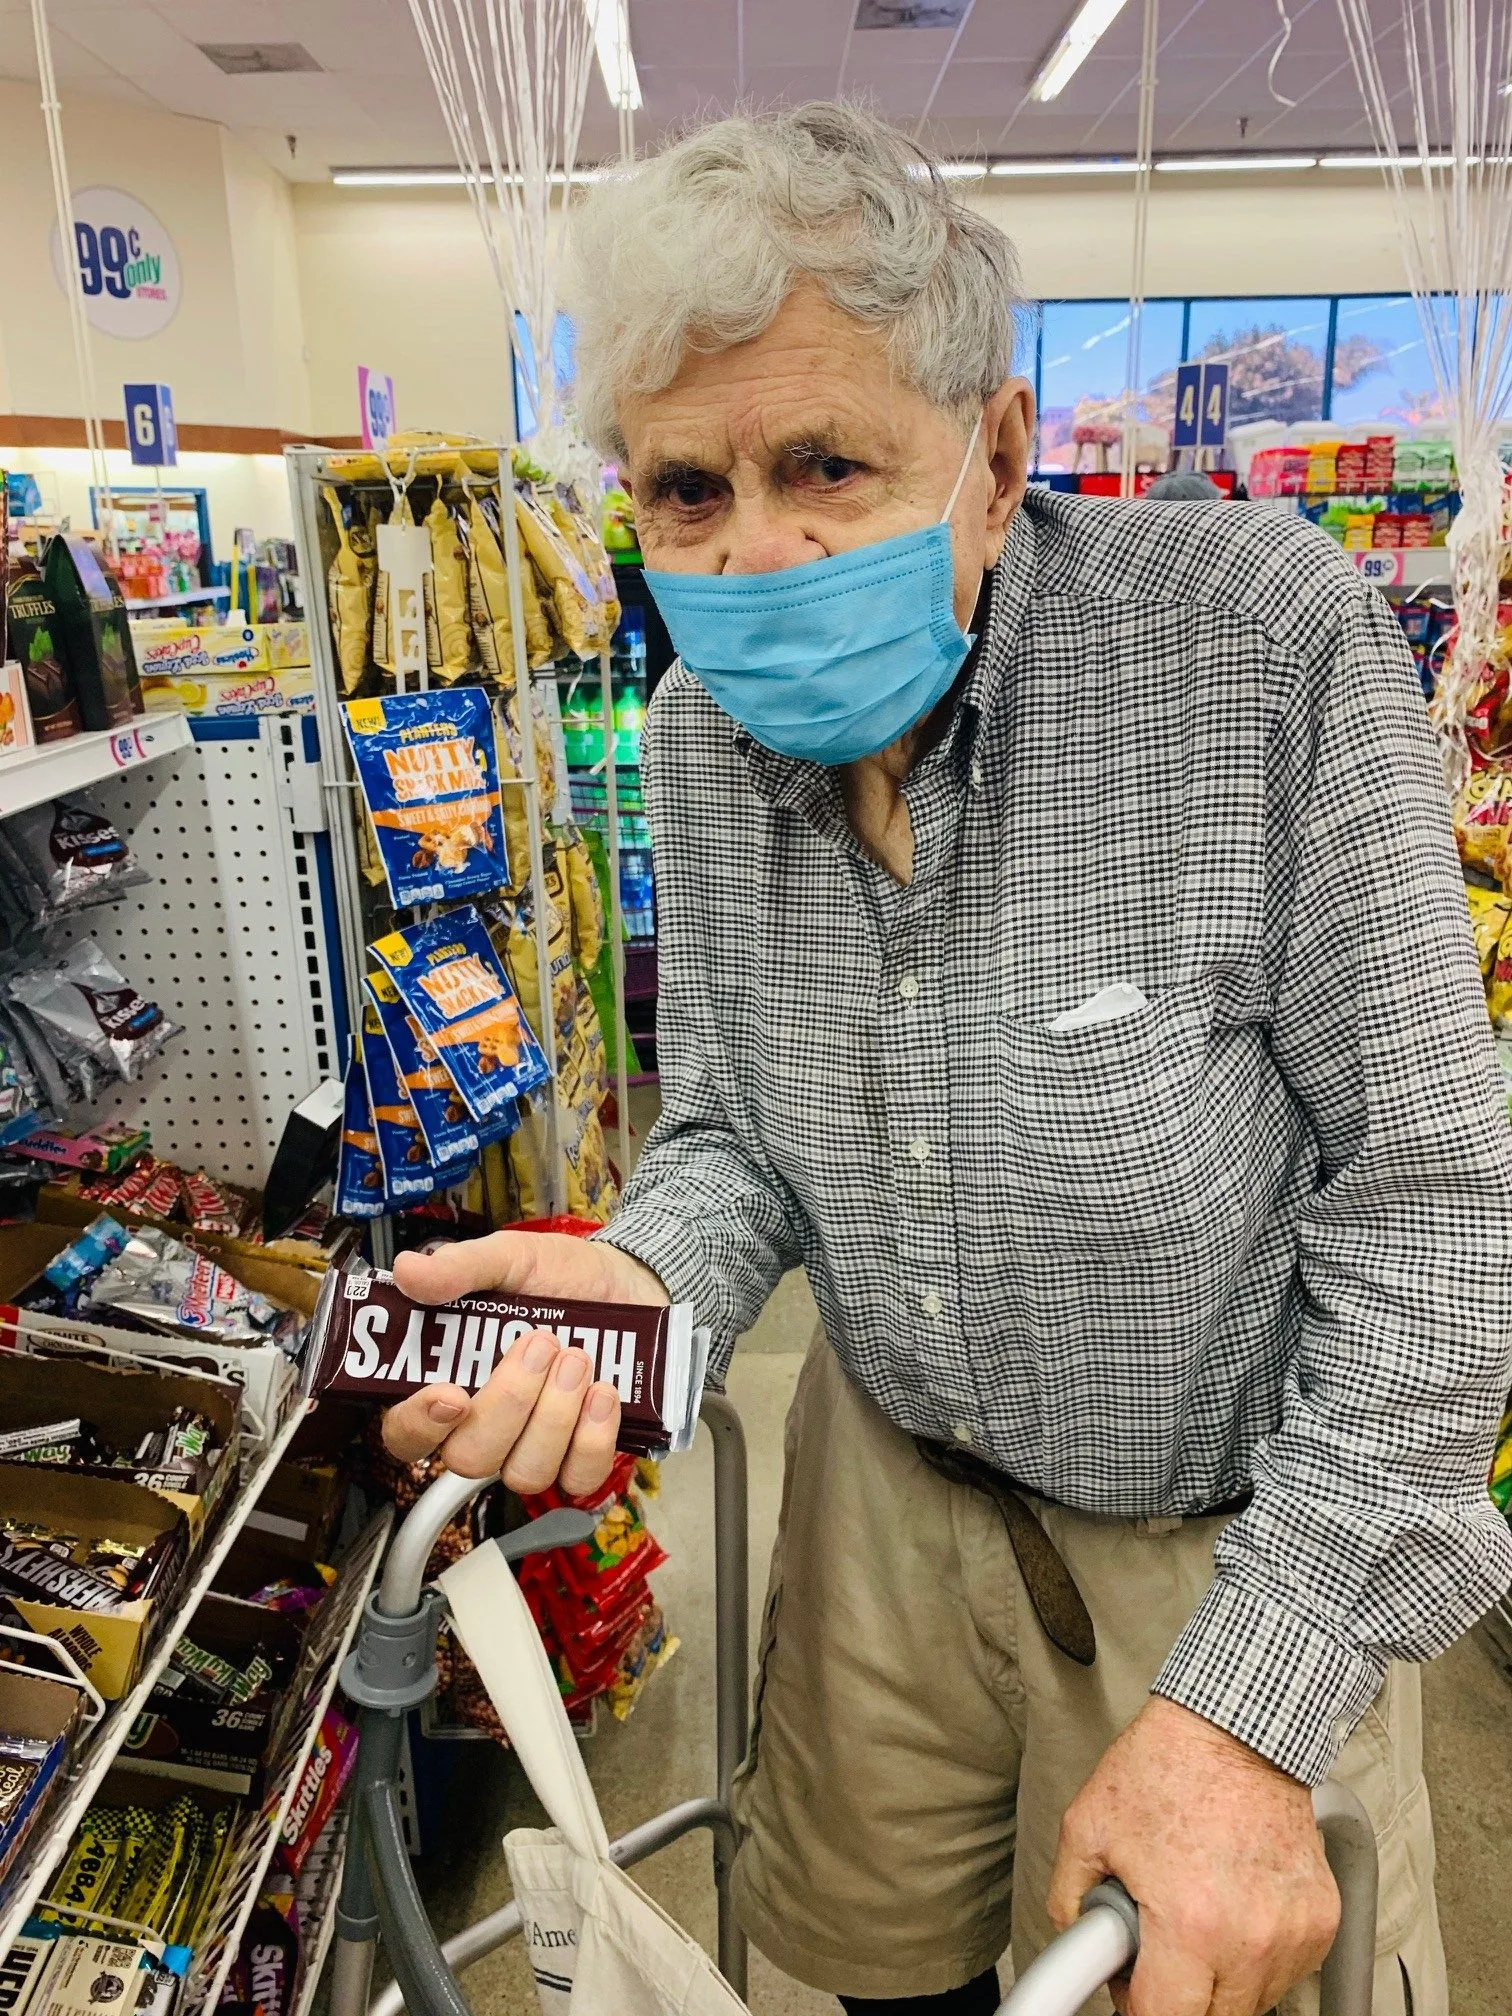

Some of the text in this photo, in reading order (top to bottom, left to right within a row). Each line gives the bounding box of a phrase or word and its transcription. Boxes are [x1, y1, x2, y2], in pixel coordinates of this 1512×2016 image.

[127, 254, 160, 286] only
[133, 403, 155, 446] 6
[1180, 384, 1196, 428] 4
[1206, 383, 1222, 427] 4
[9, 600, 56, 618] TRUFFLES
[384, 737, 475, 777] NUTTY
[531, 1307, 565, 1320] MILK
[634, 1361, 645, 1405] SINCE 1894
[68, 1623, 103, 1659] WHOLE
[211, 1708, 243, 1729] 36
[282, 1744, 334, 1847] Skittles
